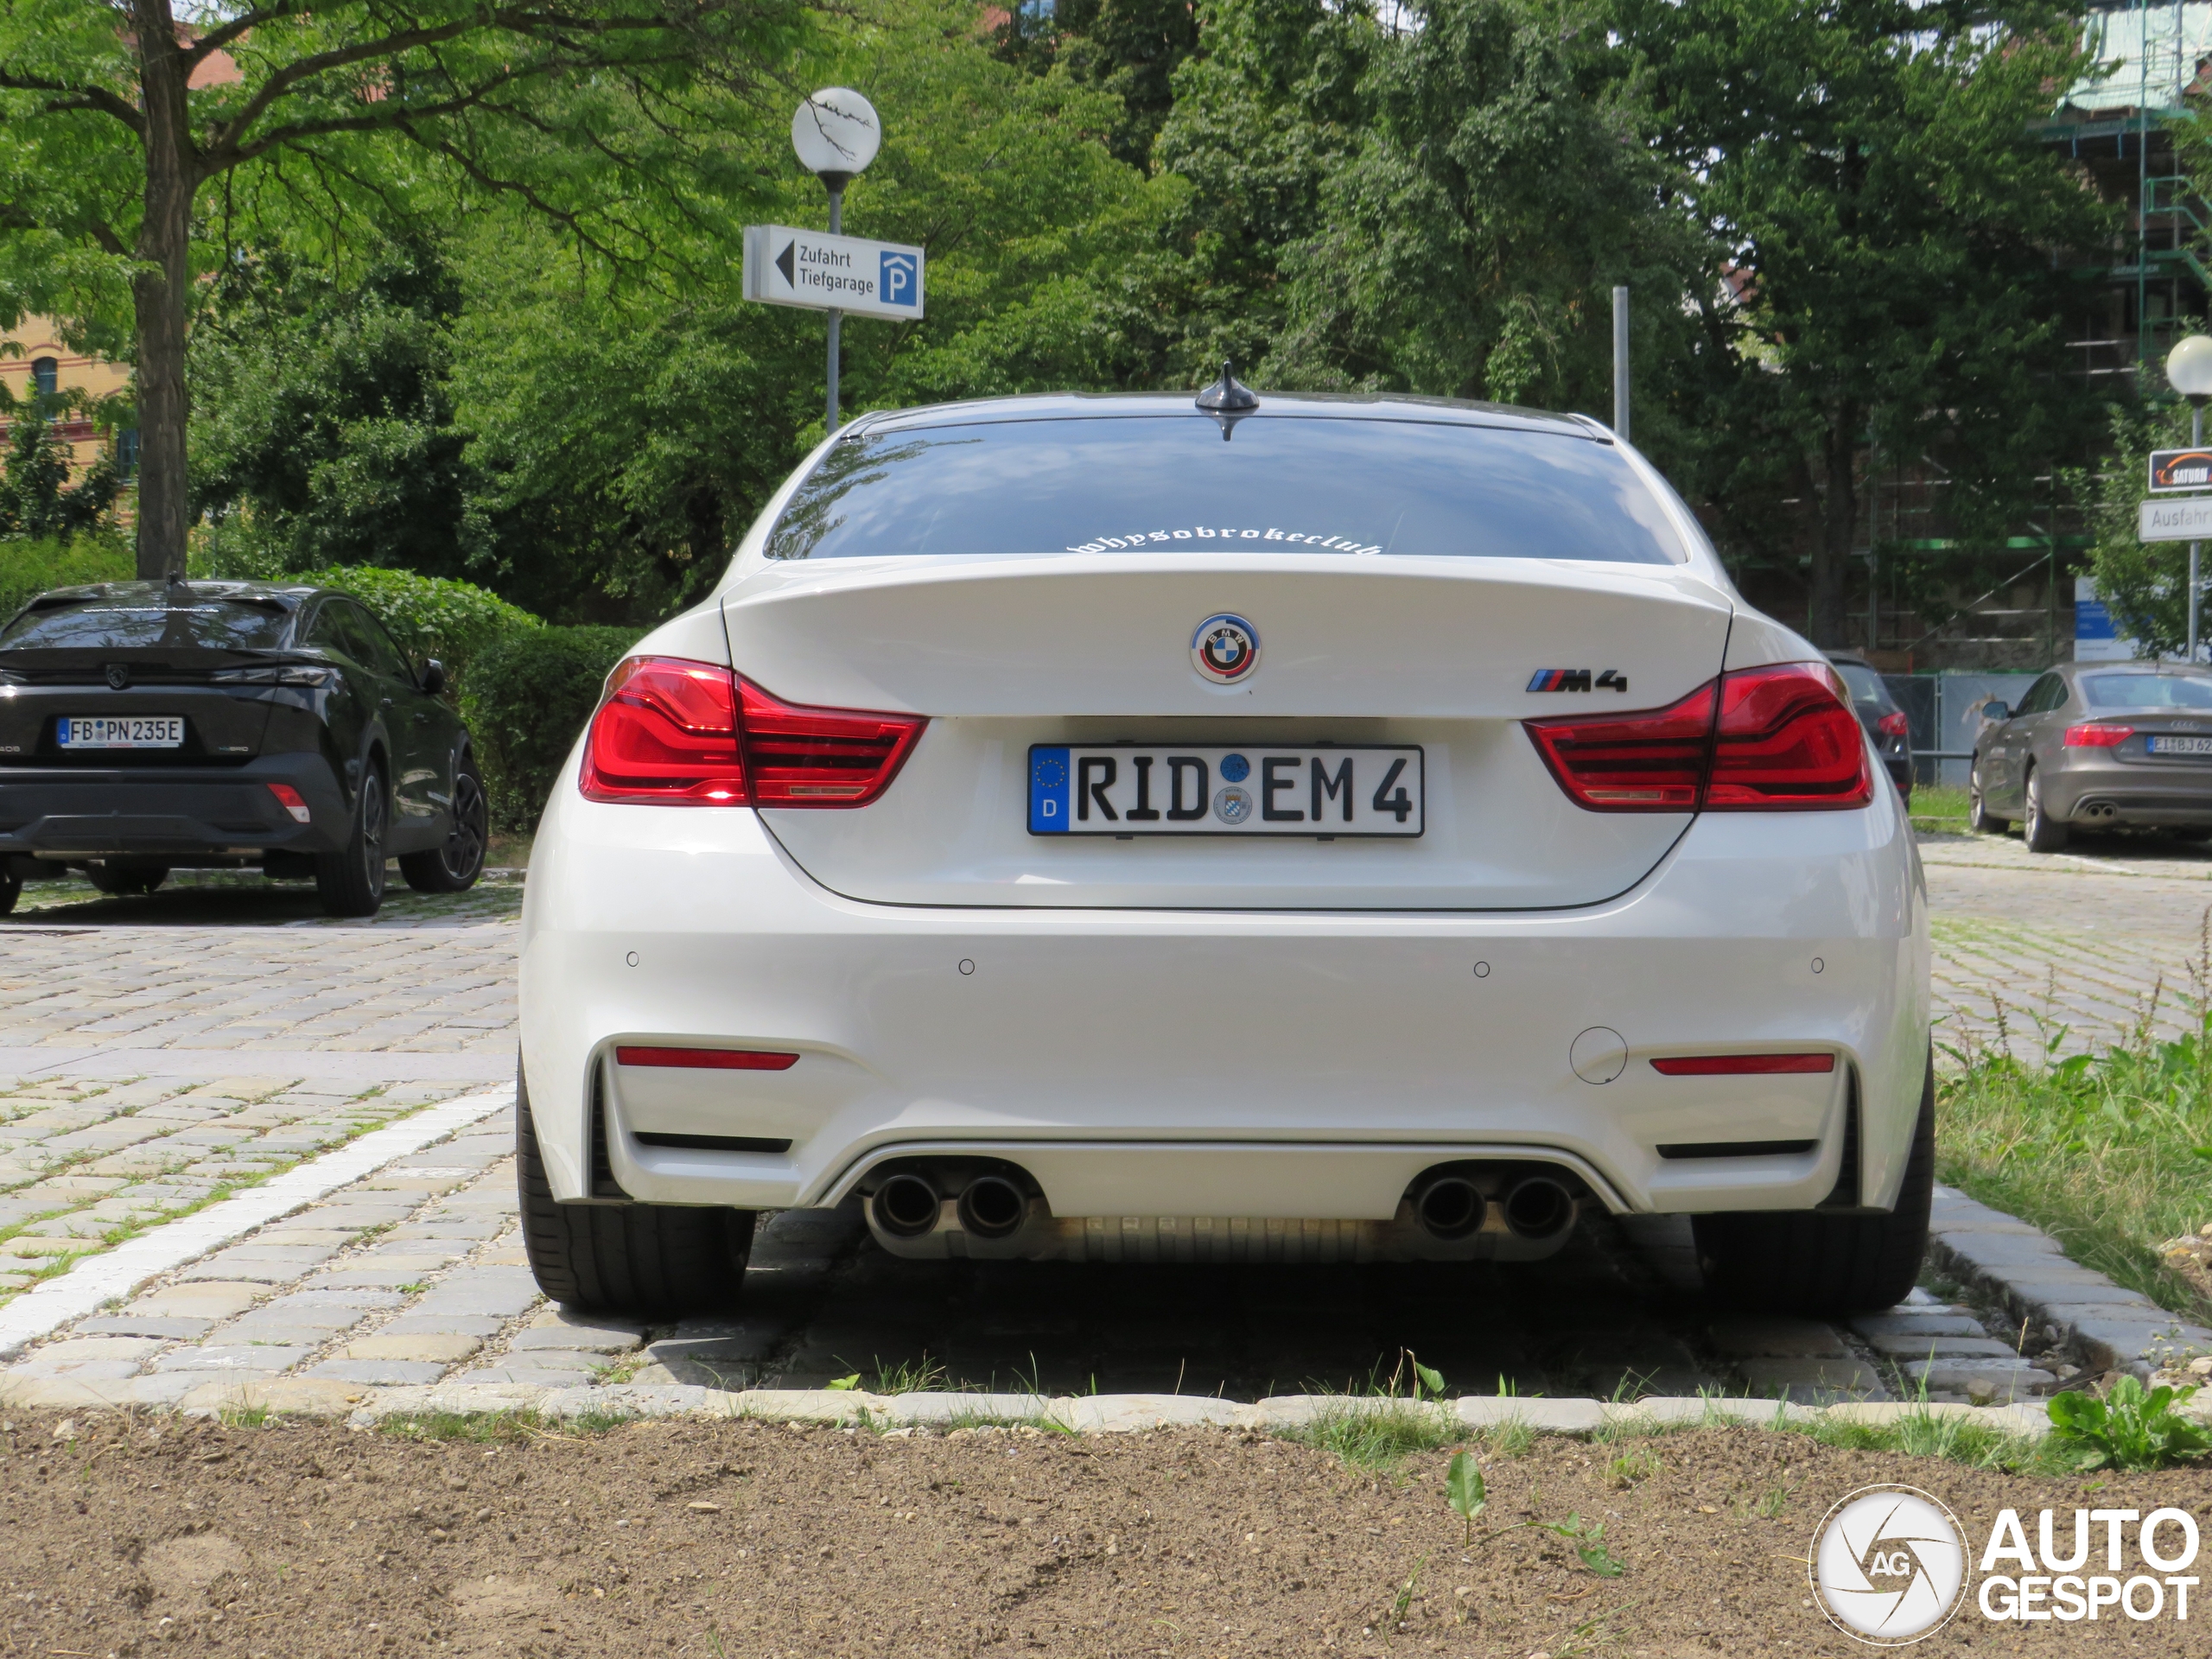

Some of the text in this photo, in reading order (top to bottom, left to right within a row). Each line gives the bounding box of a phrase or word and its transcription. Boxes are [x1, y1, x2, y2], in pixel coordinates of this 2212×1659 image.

[799, 245, 851, 268] Zufahrt
[799, 268, 874, 296] Tiefgarage
[889, 267, 907, 301] P
[2172, 467, 2209, 485] SATURN
[2152, 507, 2212, 527] Ausfahr
[1065, 525, 1383, 555] whysobrokeclub
[1208, 629, 1244, 644] BMW
[70, 721, 93, 741] FB
[1077, 756, 1413, 823] RID EM 4
[1043, 799, 1057, 817] D
